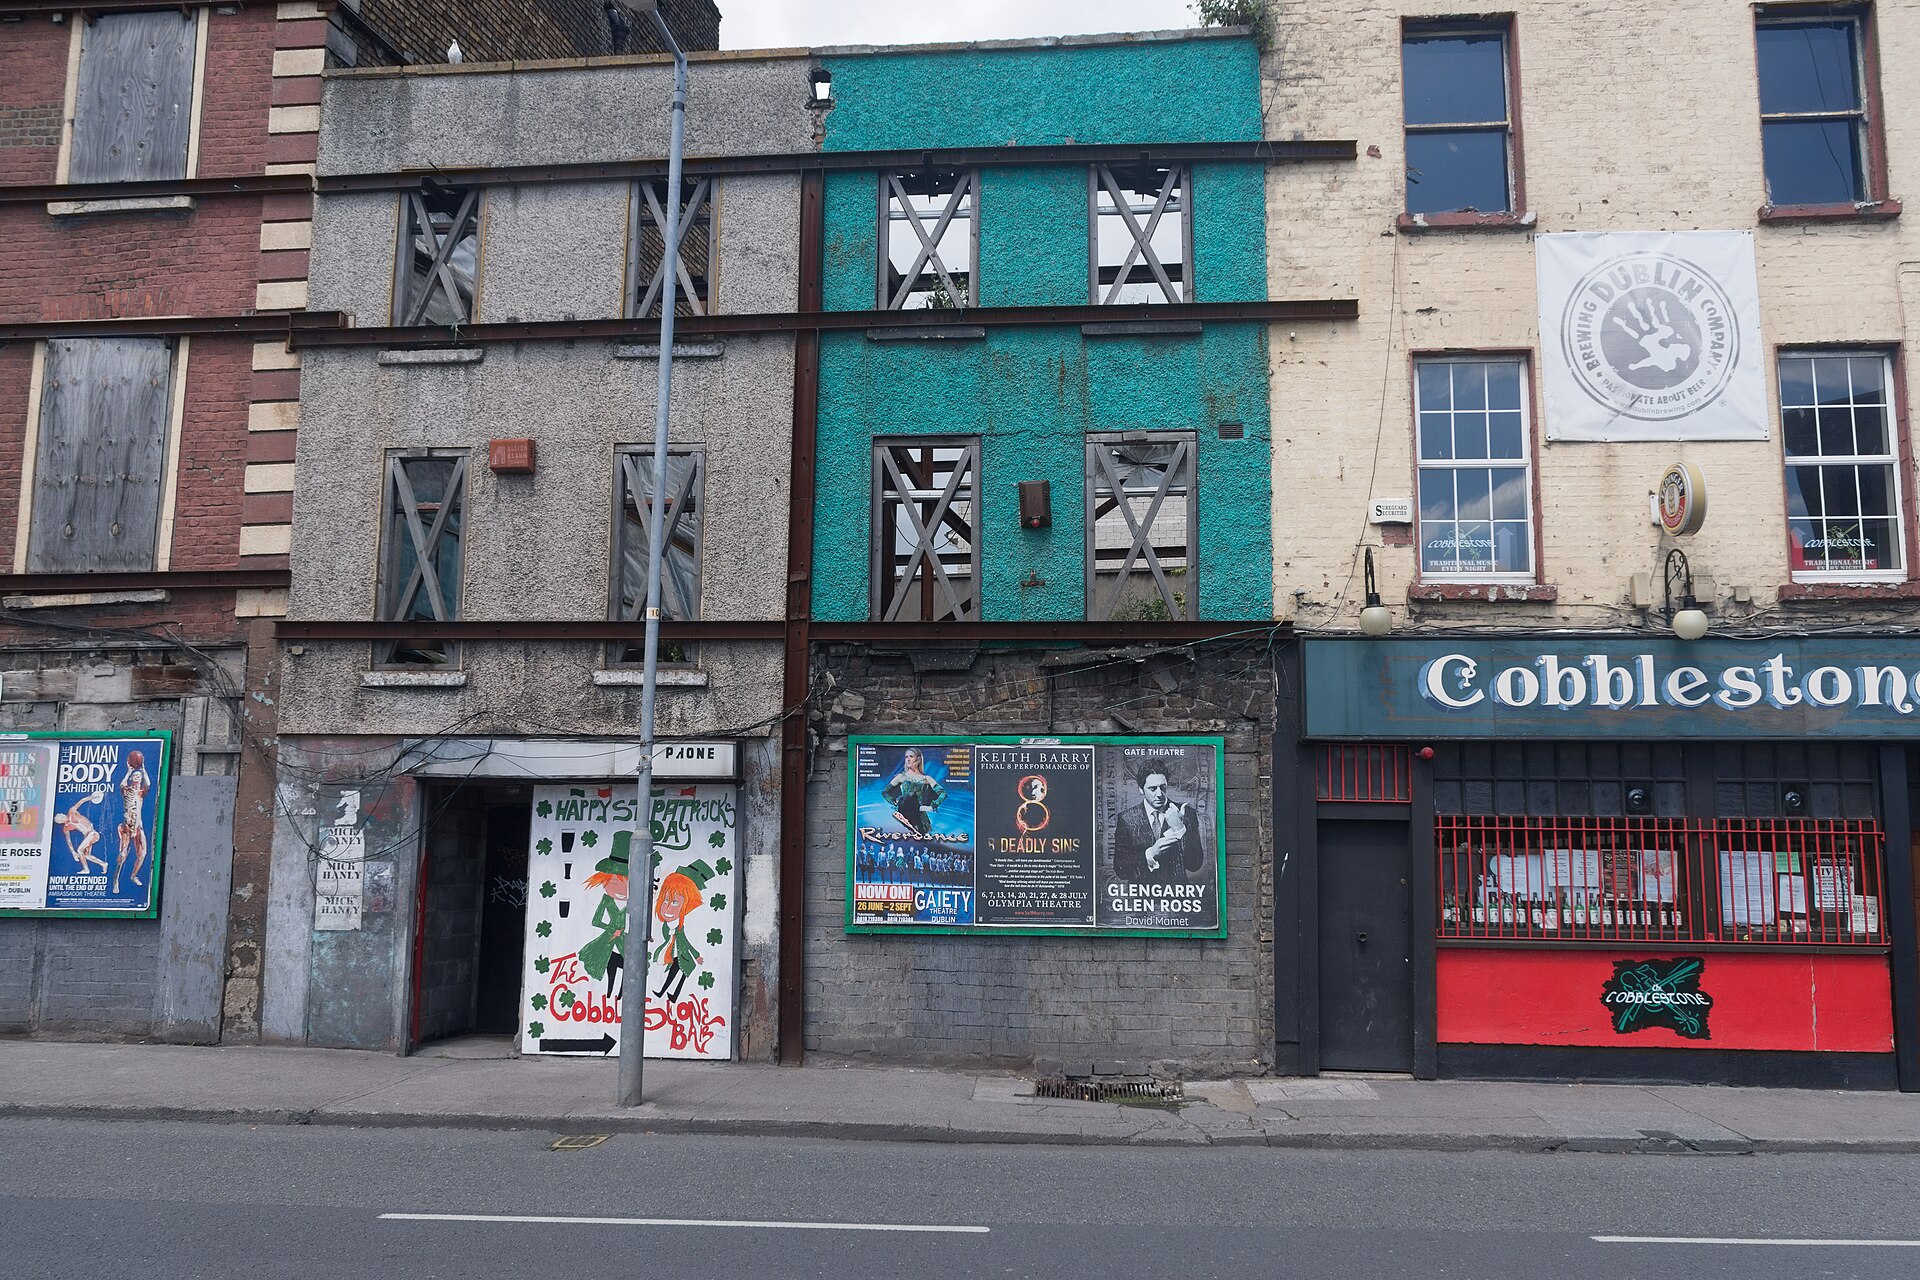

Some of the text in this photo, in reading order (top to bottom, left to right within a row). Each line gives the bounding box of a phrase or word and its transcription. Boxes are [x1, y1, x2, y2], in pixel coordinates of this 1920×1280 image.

[1589, 261, 1705, 304] DUBLIN
[1576, 299, 1598, 372] BREWING
[1699, 298, 1725, 369] COMPANY
[1657, 390, 1686, 404] ABOUT
[1687, 378, 1706, 396] BEER
[1419, 652, 1920, 713] Cobbleston
[61, 746, 70, 763] THE
[69, 745, 118, 764] HUMAN
[980, 752, 1090, 762] KEITH BARRY
[59, 764, 118, 782] BODY
[58, 783, 114, 792] EXHIBITION
[555, 800, 608, 823] HAPPY
[330, 828, 357, 836] MICK
[650, 820, 692, 850] DAY
[336, 836, 362, 844] ANLY
[1000, 838, 1046, 852] DEADLY
[1052, 838, 1080, 853] SINS
[10, 848, 42, 856] ROSES
[326, 862, 355, 870] MICK
[50, 876, 108, 884] NOW EXTENDED
[322, 871, 362, 880] HANLY
[858, 886, 910, 900] NOW ON!
[1108, 884, 1206, 898] GLENGARRY
[325, 896, 354, 905] MICK
[858, 902, 867, 911] 26
[868, 902, 884, 911] JUNE
[890, 903, 894, 911] 2
[895, 903, 912, 912] SEPT
[914, 890, 971, 912] GAIETY
[988, 900, 1082, 908] OLYMPIA THEATRE
[1112, 899, 1202, 912] GLEN ROSS
[1125, 916, 1189, 926] David Mamet
[550, 952, 590, 984] The
[1605, 991, 1710, 1005] COBBLESTONE
[670, 1024, 714, 1054] BAR
